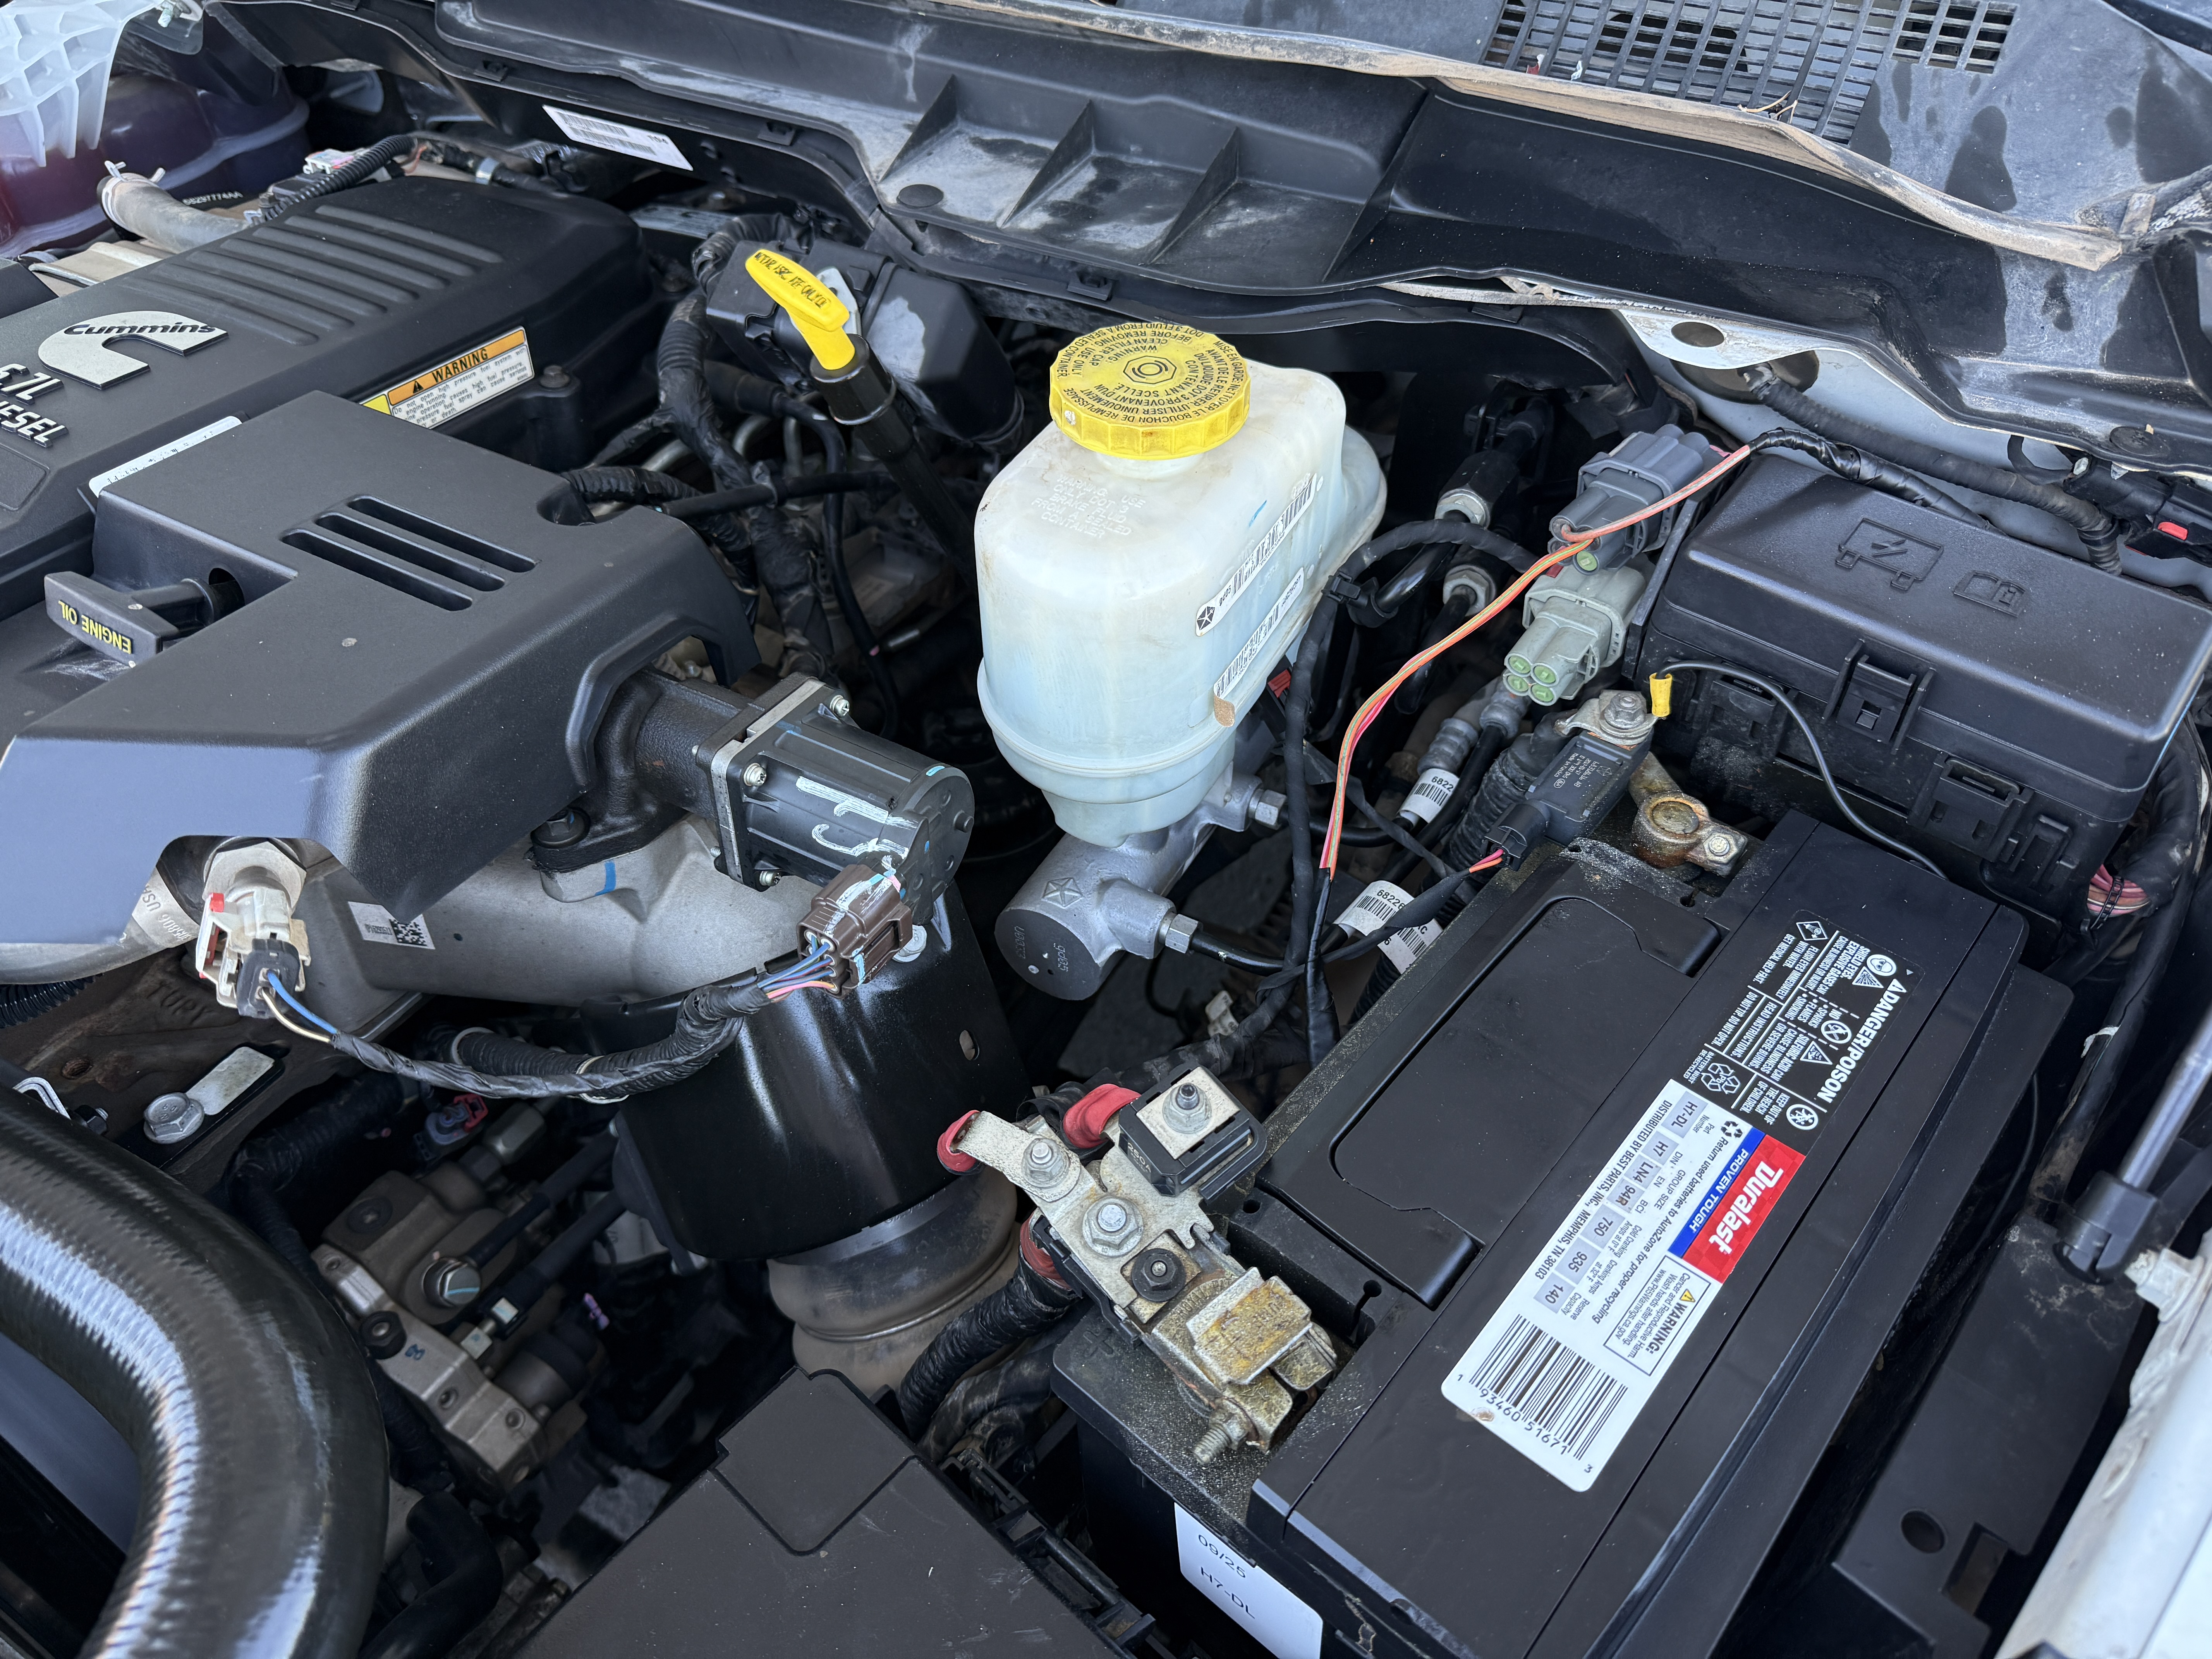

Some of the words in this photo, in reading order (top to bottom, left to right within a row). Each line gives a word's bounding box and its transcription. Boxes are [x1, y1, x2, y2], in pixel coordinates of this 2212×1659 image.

[64, 322, 216, 335] Cummins
[1113, 322, 1143, 331] FROM
[1151, 330, 1192, 342] BEFORE
[1183, 327, 1205, 337] DOT
[1073, 329, 1107, 347] SEALED
[1098, 339, 1132, 355] FILLER
[1213, 340, 1233, 353] MISE
[1056, 345, 1080, 379] CONTAINER.
[1076, 346, 1096, 359] USE
[1087, 354, 1105, 366] CAP
[1104, 345, 1158, 363] WARNING:
[1193, 352, 1209, 361] DU
[1205, 347, 1227, 366] AVANT
[1226, 353, 1240, 361] EN
[432, 347, 488, 385] WARNING
[1071, 359, 1085, 375] ONLY
[1200, 361, 1214, 385] LIQUIDE
[1231, 362, 1243, 383] GARDE:
[1162, 359, 1199, 397] CONTENANT
[1080, 388, 1139, 414] UNIQUEMENT
[1093, 384, 1116, 398] D'UN
[1112, 394, 1182, 406] PROVENANT
[1187, 385, 1207, 397] DOT
[1187, 384, 1224, 408] RETIRER.
[1204, 384, 1240, 411] NETTOYER
[1063, 388, 1119, 419] REMPLISSAGE
[1142, 403, 1191, 415] UTILISER
[1192, 408, 1206, 416] LE
[1138, 412, 1192, 422] BOUCHON
[1031, 498, 1066, 514] FROM
[1069, 511, 1079, 519] A
[1085, 515, 1132, 535] SEALED
[1049, 493, 1089, 511] BRAKE
[1092, 507, 1127, 523] FLUID
[58, 600, 78, 625] OIL
[81, 614, 132, 654] ENGINE
[1833, 940, 1860, 970] EXPLOSIVE
[1850, 945, 1870, 966] SHIELD
[1821, 967, 1841, 987] GASES
[1839, 963, 1858, 981] EYES.
[1815, 983, 1829, 995] CAN
[1759, 1001, 1778, 1019] READ
[1784, 995, 1807, 1020] SMOKING
[1796, 1001, 1818, 1023] FLAMES
[1807, 1006, 1828, 1029] SPARKS
[1828, 1008, 1843, 1020] NO
[1729, 1015, 1767, 1060] INSTRUCTIONS.
[1774, 1022, 1788, 1032] OR
[1779, 1028, 1798, 1047] CAUSE
[1761, 1029, 1783, 1051] SEVERE
[1785, 1033, 1810, 1060] SULFURIC
[1815, 990, 1901, 1103] DANGER/POISON
[1747, 1048, 1769, 1070] BURNS.
[1759, 1043, 1787, 1074] BLINDNESS
[1776, 1056, 1794, 1072] ACID
[1755, 1080, 1769, 1091] OF
[1769, 1068, 1785, 1082] CAN
[1739, 1087, 1764, 1114] CHILDREN.
[1765, 1087, 1779, 1099] THE
[1774, 1092, 1790, 1108] KEEP
[1670, 1100, 1698, 1130] H7-DL
[1754, 1096, 1773, 1115] REACH
[1767, 1104, 1782, 1118] OUT
[1636, 1099, 1673, 1143] DISTRIBUTED
[1692, 1114, 1710, 1134] Number
[1702, 1123, 1715, 1135] Part
[1762, 1115, 1775, 1125] OF
[1628, 1140, 1643, 1152] BY
[1650, 1140, 1669, 1157] H7
[1706, 1136, 1729, 1163] Return
[1615, 1150, 1635, 1170] BEST
[1669, 1151, 1683, 1165] DIN
[1596, 1166, 1622, 1194] PARTS,
[1632, 1161, 1654, 1184] LN4
[1694, 1160, 1712, 1180] used
[1714, 1147, 1750, 1194] PROVEN
[1653, 1175, 1665, 1188] EN
[1664, 1169, 1686, 1195] GROUP
[1584, 1190, 1604, 1210] INC.,
[1614, 1184, 1637, 1207] 94R
[1653, 1193, 1669, 1210] SIZE
[1673, 1177, 1700, 1210] batteries
[1634, 1199, 1648, 1214] BCI
[1667, 1207, 1679, 1218] to
[1687, 1192, 1719, 1232] TOUGH
[1706, 1158, 1784, 1256] Duralast
[1557, 1208, 1591, 1247] MEMPHIS,
[1592, 1216, 1614, 1238] 750
[1628, 1224, 1642, 1238] Cold
[1642, 1215, 1674, 1254] AutoZone
[1551, 1243, 1565, 1258] TN
[1613, 1235, 1634, 1259] Cranking
[1534, 1254, 1557, 1280] 38103
[1566, 1250, 1589, 1273] 935
[1633, 1250, 1649, 1266] for
[1597, 1258, 1618, 1282] Cranking
[1614, 1261, 1638, 1290] proper
[1587, 1278, 1603, 1295] Amps
[1661, 1272, 1678, 1291] Wash
[1671, 1272, 1691, 1295] Cancer
[1543, 1282, 1565, 1305] 140
[1560, 1291, 1582, 1316] Capacity
[1613, 1267, 1667, 1341] www.P65Warnings.ca.gov
[1649, 1288, 1666, 1309] hands
[1664, 1292, 1677, 1306] and
[1570, 1298, 1590, 1321] Reserve
[1590, 1286, 1623, 1326] recycling
[1639, 1306, 1655, 1322] after
[1621, 1318, 1645, 1348] handling.
[1638, 1303, 1669, 1343] Reproductive
[1645, 1301, 1687, 1356] WARNING:
[1627, 1340, 1645, 1361] Harm.
[1455, 1373, 1464, 1382] 1
[1477, 1387, 1522, 1423] 93460
[1523, 1420, 1568, 1456] 51671
[1583, 1463, 1593, 1475] 3
[1198, 1534, 1246, 1578] 09/25
[1200, 1566, 1255, 1619] H7-DL
